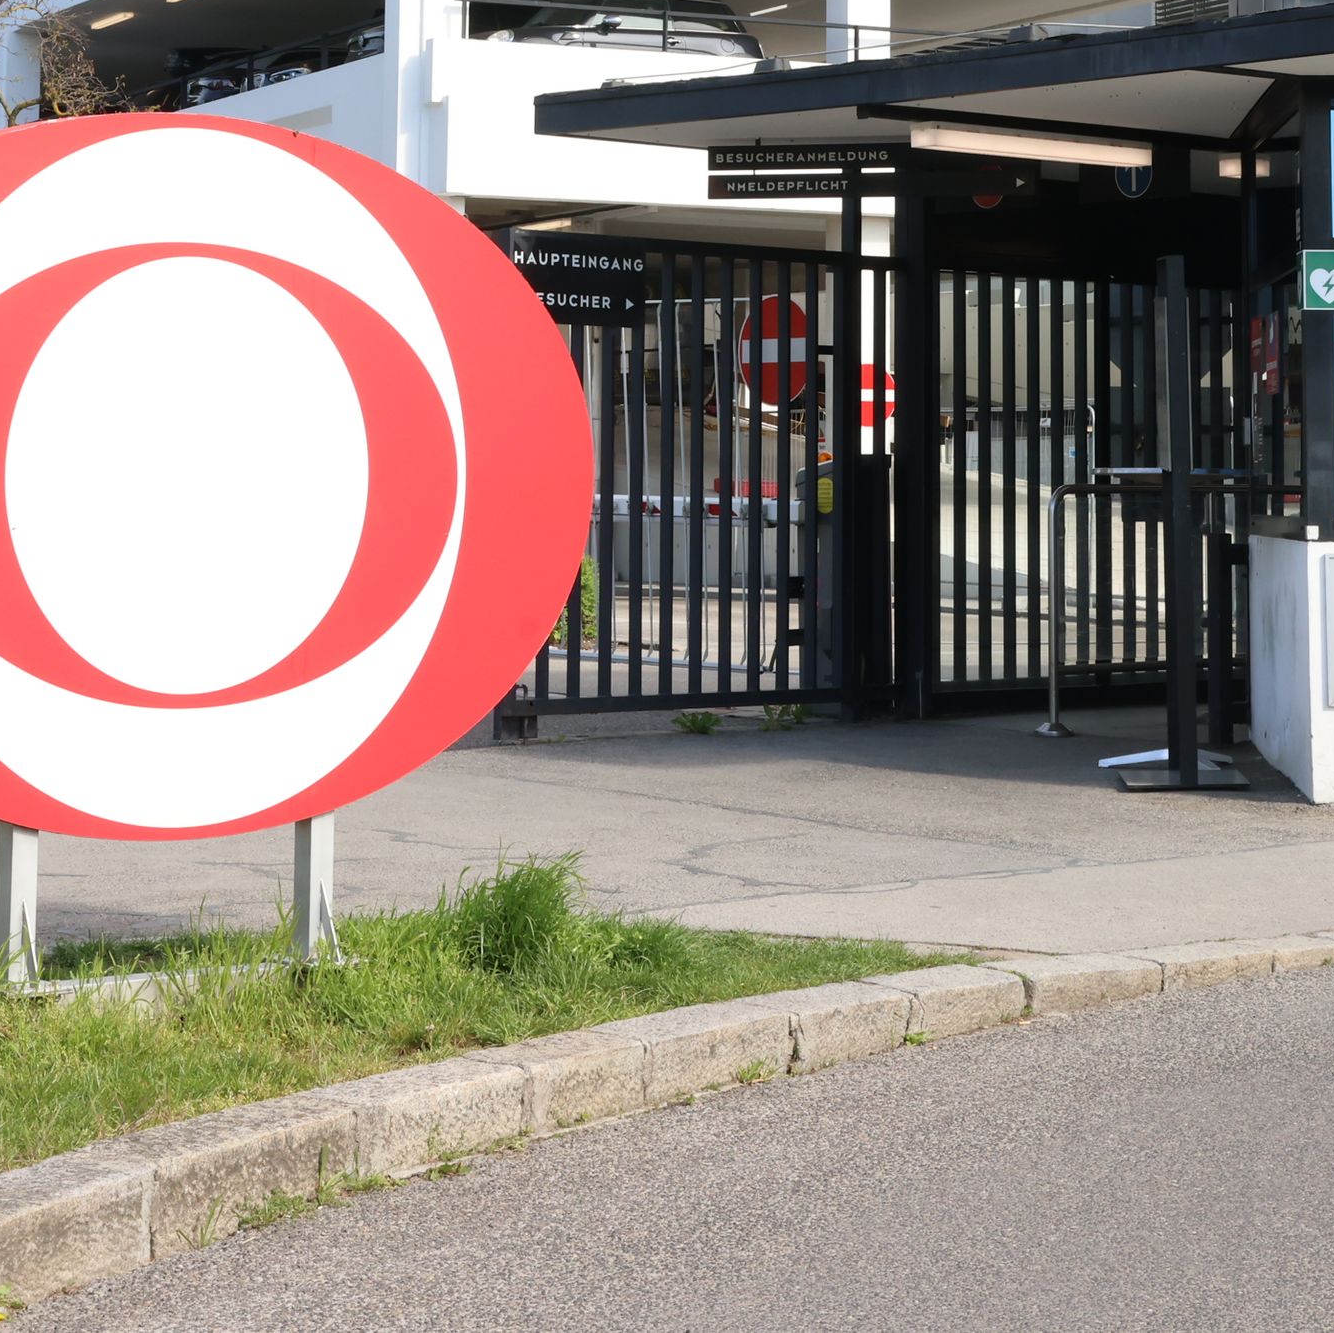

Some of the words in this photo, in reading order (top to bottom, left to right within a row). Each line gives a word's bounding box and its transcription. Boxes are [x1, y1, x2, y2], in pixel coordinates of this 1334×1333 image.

[715, 150, 889, 164] BESUCHERANMELDUNG
[514, 250, 644, 272] HAUPTEINGANG
[535, 292, 611, 309] ESUCHER
